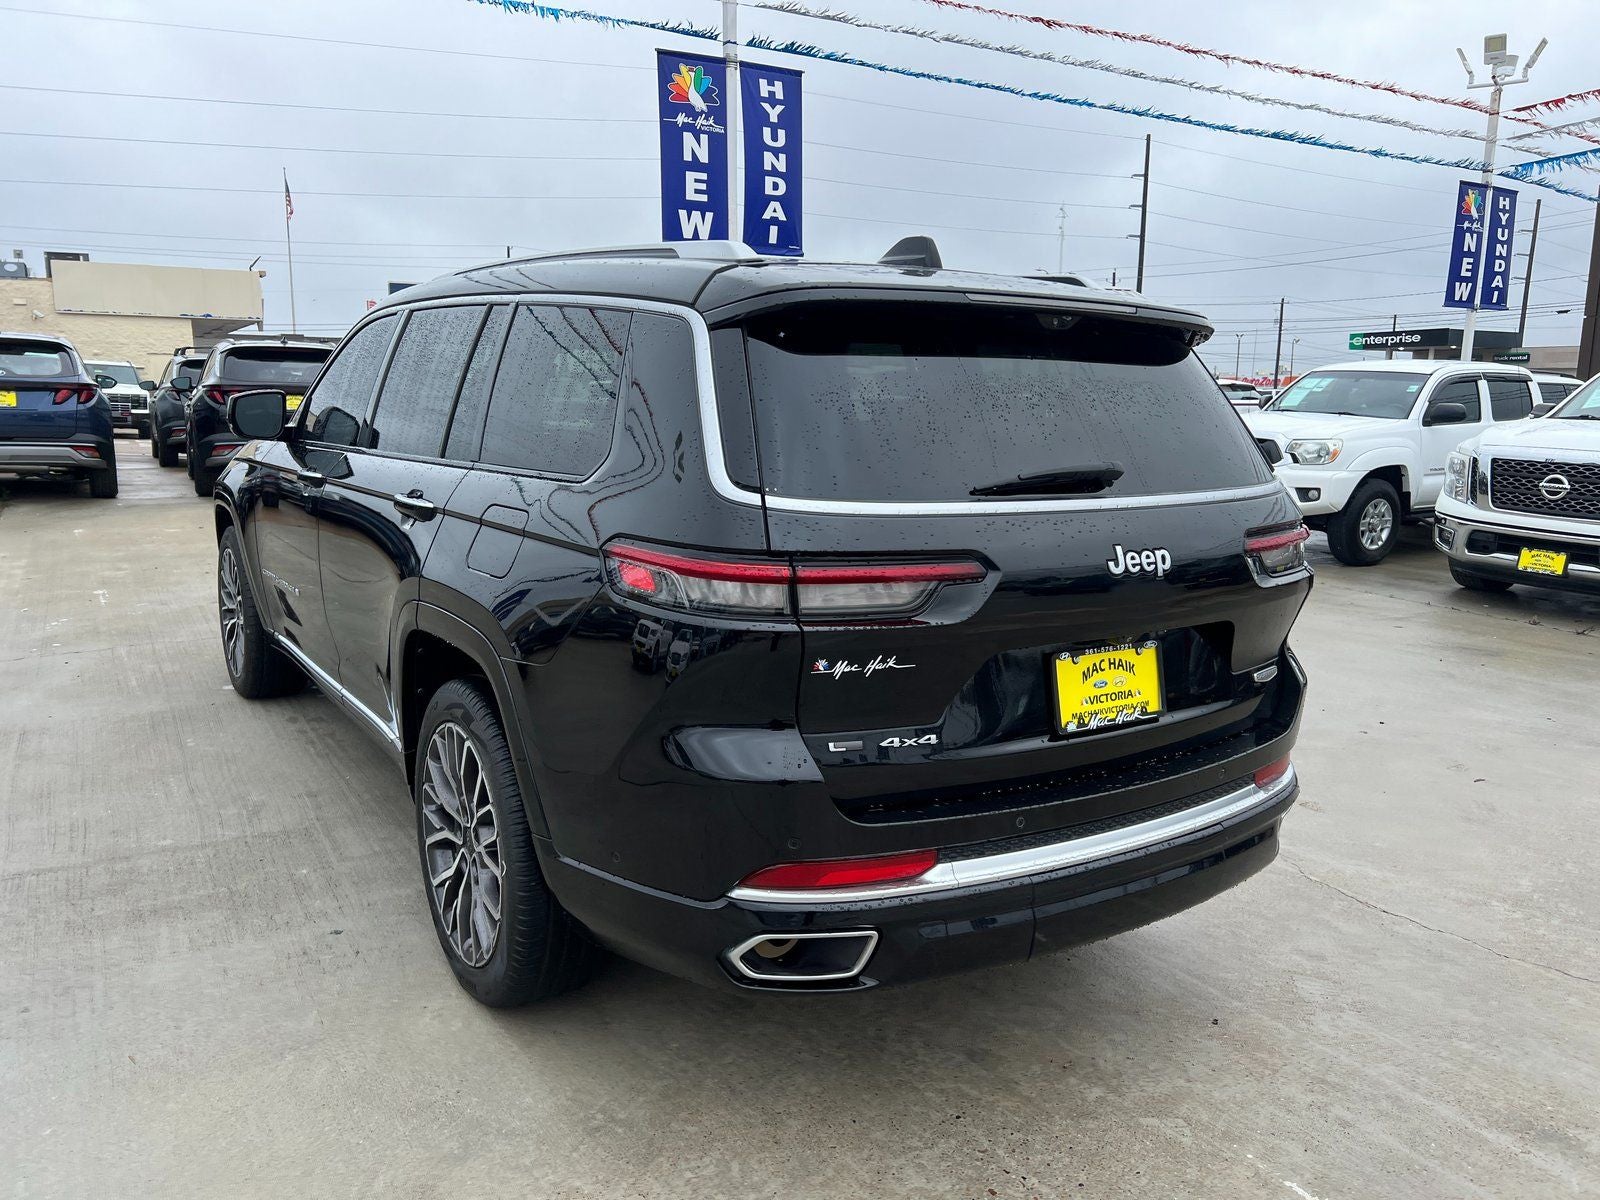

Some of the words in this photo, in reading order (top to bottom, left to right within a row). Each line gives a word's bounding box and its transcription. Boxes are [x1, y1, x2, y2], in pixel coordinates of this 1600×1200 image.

[663, 112, 695, 127] Mac
[695, 114, 724, 129] Haik
[759, 78, 787, 244] HYUNDAI
[678, 131, 713, 240] NEW
[1491, 196, 1510, 303] HYUNDAI
[1454, 232, 1477, 301] NEW
[1350, 333, 1421, 346] enterprise
[1107, 545, 1171, 577] Jeep
[811, 660, 862, 679] Mac
[864, 655, 916, 677] Haik
[1082, 659, 1106, 684] MAC
[1108, 657, 1136, 676] HAIK
[1088, 689, 1134, 705] VICTORIA
[1076, 714, 1115, 731] Mac
[1115, 708, 1157, 725] Haik
[879, 734, 938, 748] 4x4
